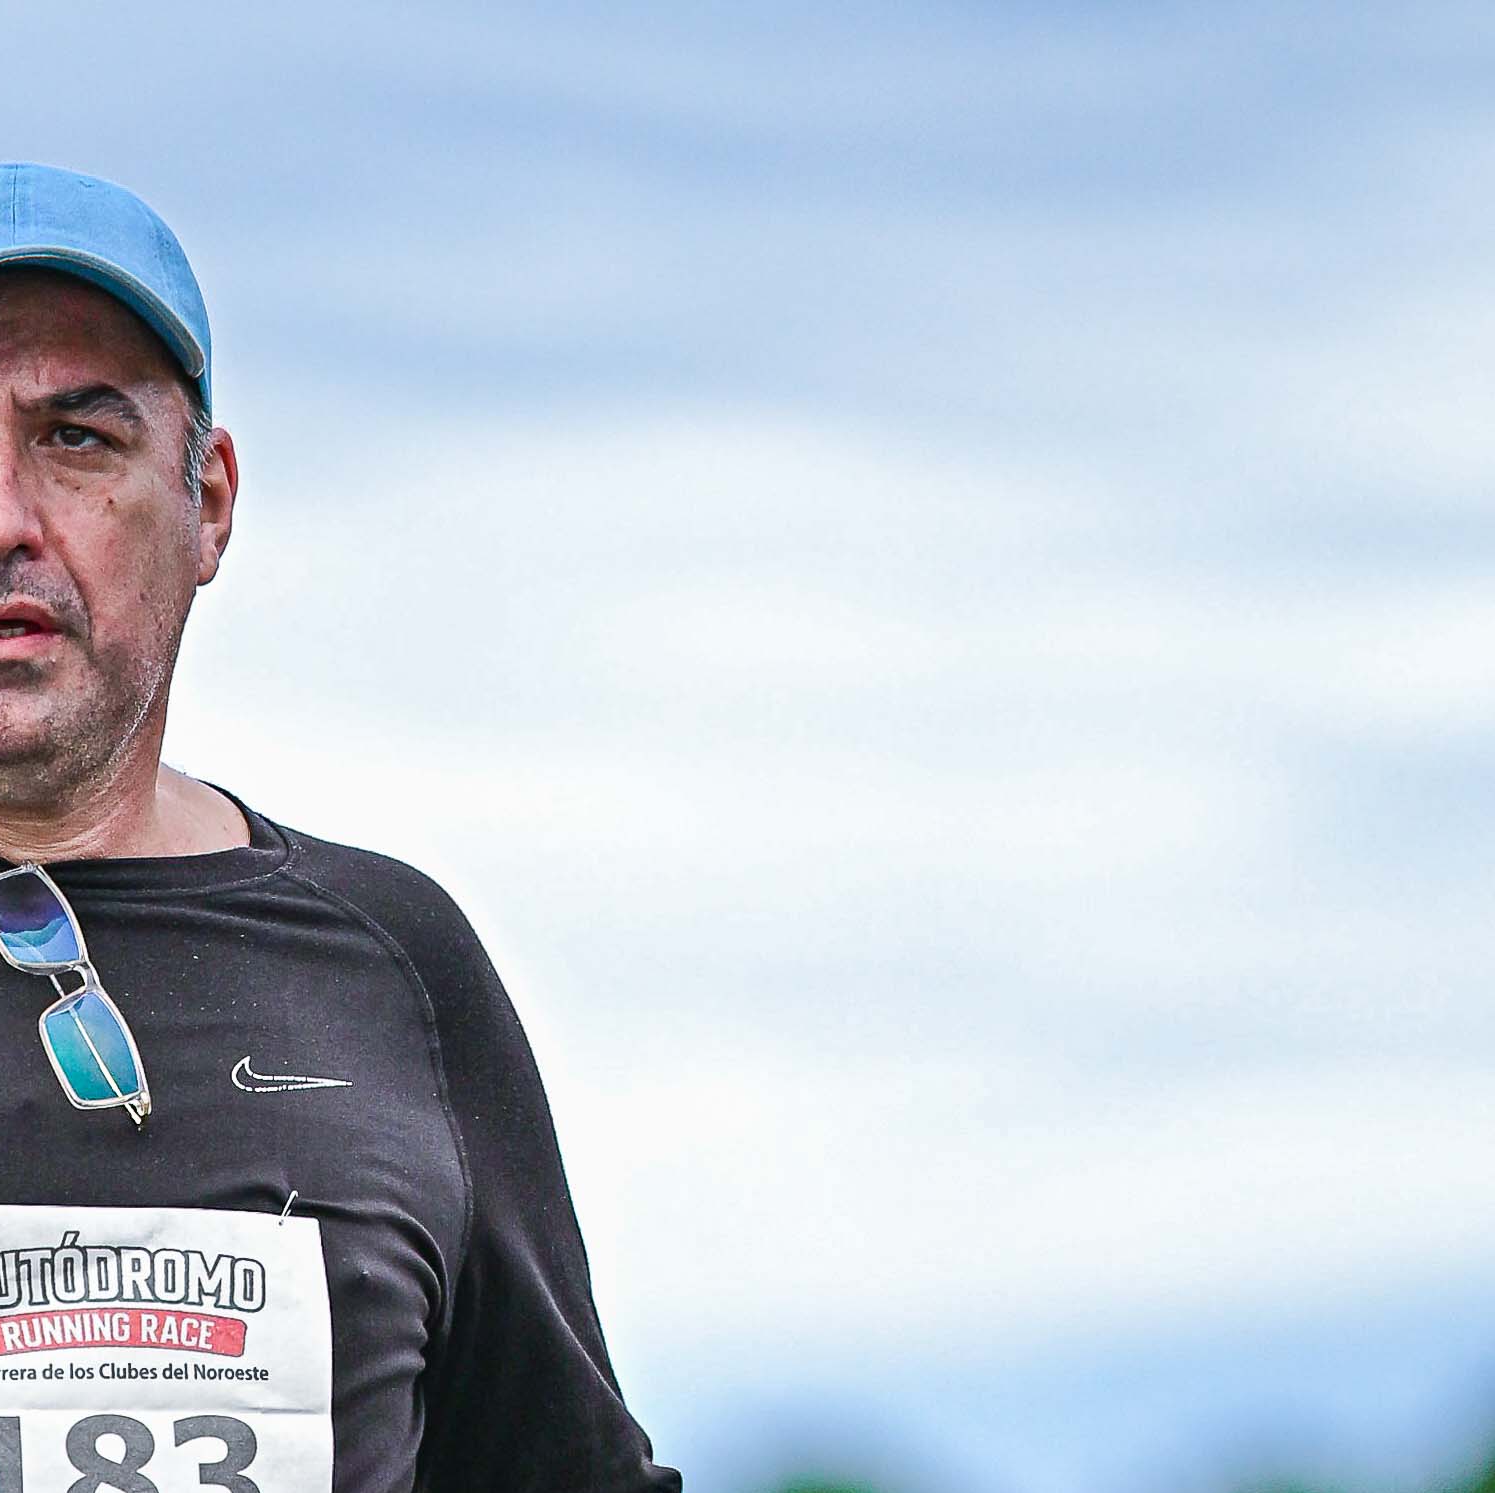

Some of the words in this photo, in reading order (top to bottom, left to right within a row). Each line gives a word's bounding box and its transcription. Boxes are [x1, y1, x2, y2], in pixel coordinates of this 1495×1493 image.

[0, 1312, 131, 1351] RUNNING
[140, 1313, 215, 1350] RACE
[41, 1362, 65, 1380] de
[69, 1362, 95, 1380] los
[98, 1362, 159, 1380] Clubes
[161, 1362, 189, 1380] del
[193, 1363, 270, 1382] Noroeste
